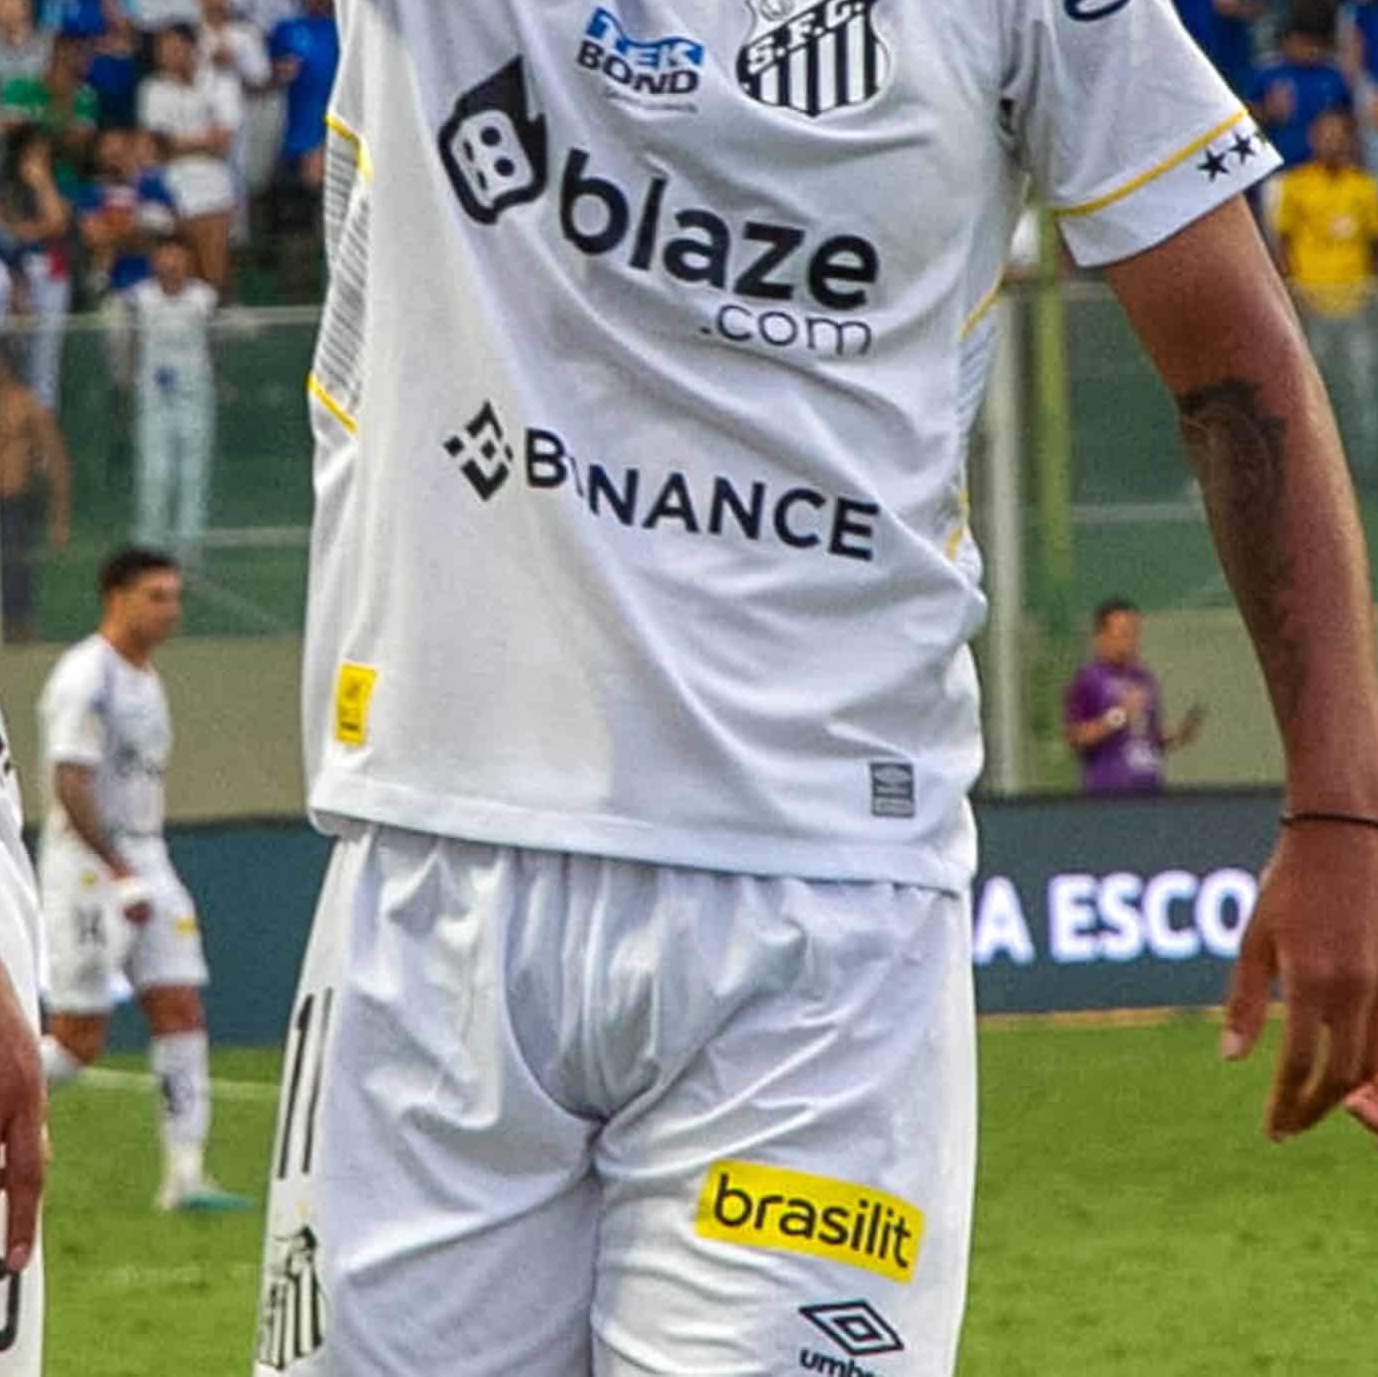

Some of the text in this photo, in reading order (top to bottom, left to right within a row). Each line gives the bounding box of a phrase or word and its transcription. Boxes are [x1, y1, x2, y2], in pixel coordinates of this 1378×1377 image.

[577, 40, 699, 94] BOND
[559, 148, 880, 310] blaze
[699, 304, 872, 356] .com
[525, 428, 880, 561] BINANCE
[1048, 868, 1258, 962] ESCO
[714, 1172, 911, 1269] brasilit
